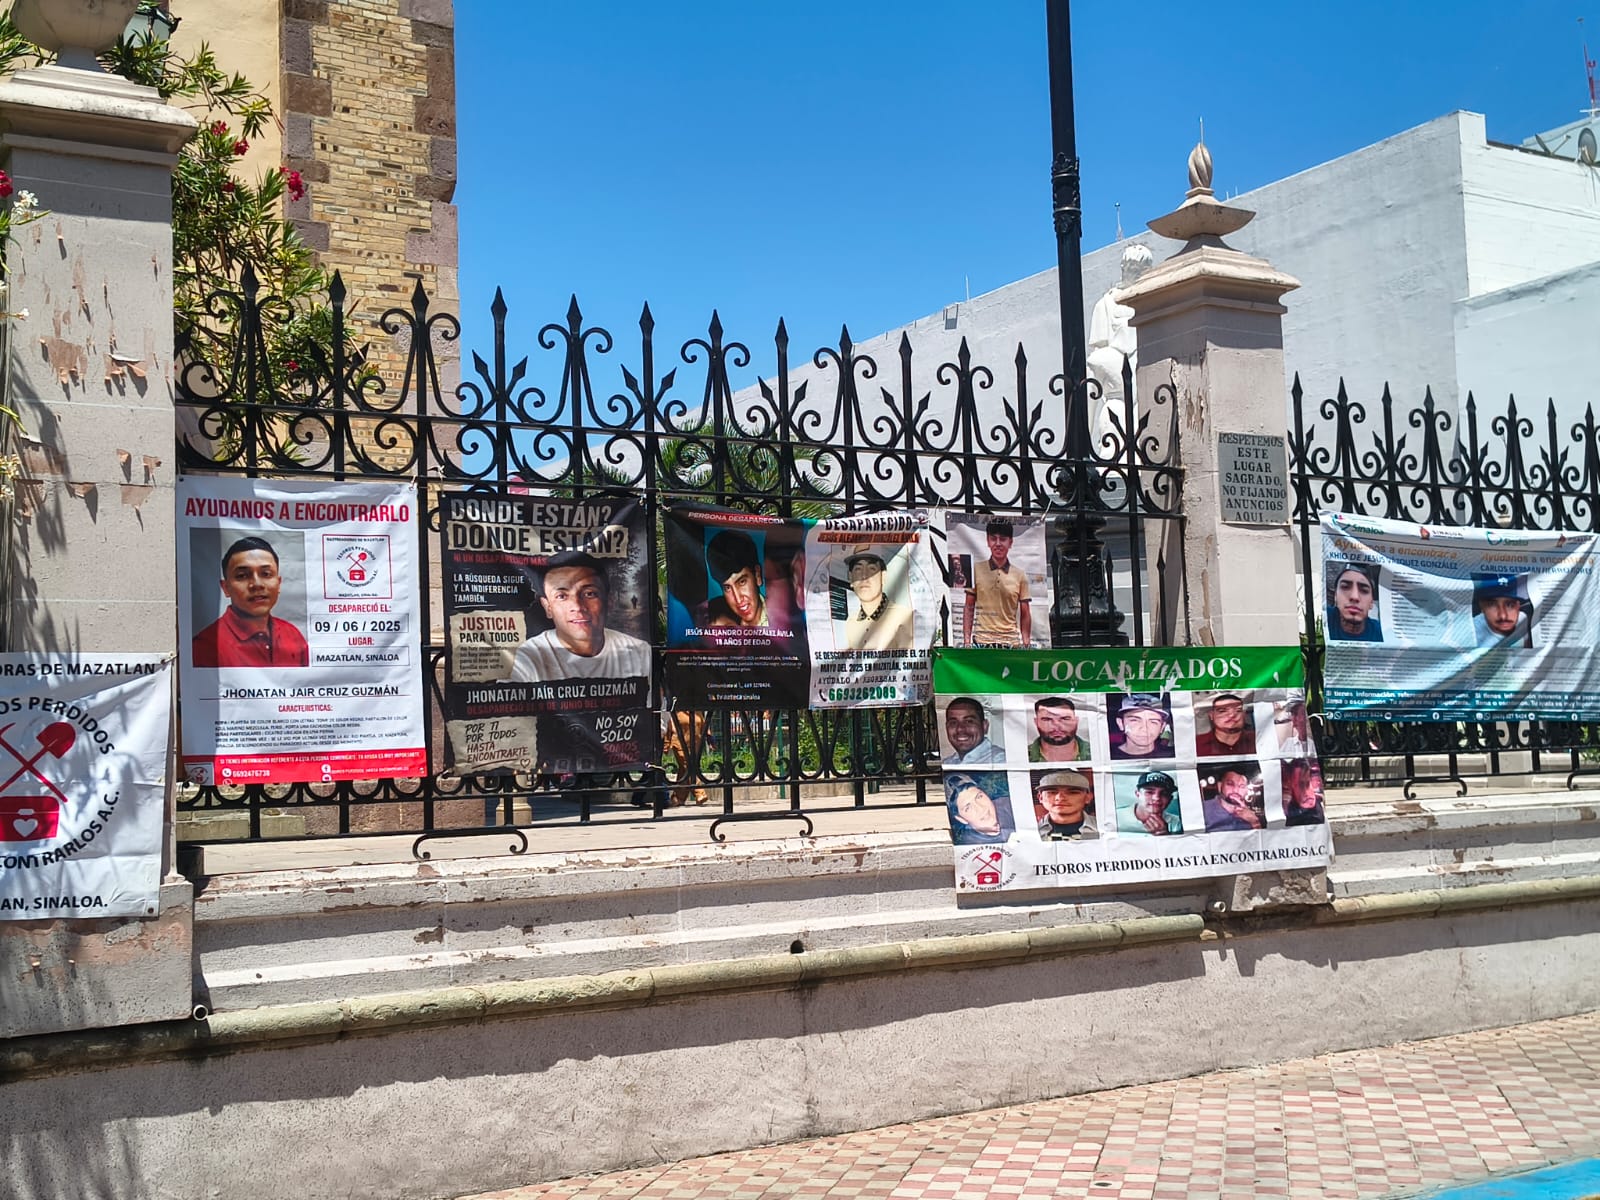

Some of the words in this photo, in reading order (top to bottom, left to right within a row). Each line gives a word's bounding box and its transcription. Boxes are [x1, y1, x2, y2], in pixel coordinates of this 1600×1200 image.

[1219, 432, 1284, 447] RESPETEMOS
[1238, 448, 1268, 459] ESTE
[1234, 461, 1272, 472] LUGAR
[1226, 473, 1282, 486] SAGRADO.
[1222, 485, 1236, 496] NO
[1240, 486, 1286, 498] FIJANDO
[185, 498, 274, 520] AYUDANOS
[279, 504, 290, 520] A
[295, 503, 410, 522] ENCONTRARLO
[1226, 498, 1284, 510] ANUNCIOS
[452, 500, 524, 524] DONDE
[532, 500, 612, 528] ESTÁN?
[688, 512, 727, 520] PERSONA
[728, 515, 784, 524] DESAPARECIDA
[826, 516, 912, 531] DESAPARECIDO
[452, 524, 530, 552] DONDE
[1420, 558, 1458, 569] GONZÁLEZ
[1480, 564, 1508, 572] CARLOS
[454, 574, 462, 582] LA
[464, 573, 502, 584] BÚSQUEDA
[503, 576, 525, 584] SIGUE
[454, 584, 458, 592] Y
[460, 584, 470, 592] LA
[471, 584, 518, 594] INDIFERENCIA
[454, 593, 488, 603] TAMBIÉN.
[328, 603, 378, 613] DESAPARECIÓ
[381, 604, 392, 613] EL:
[315, 622, 330, 632] 09
[343, 622, 358, 632] 06
[370, 620, 400, 632] 2025
[459, 616, 516, 631] JUSTICIA
[460, 632, 486, 642] PARA
[489, 632, 520, 642] TODOS
[686, 628, 703, 636] JESÚS
[704, 628, 742, 637] ALEJANDRO
[348, 637, 375, 646] LUGAR:
[724, 638, 742, 646] AÑOS
[316, 654, 364, 662] MAZATLAN,
[366, 654, 400, 662] SINALOA
[815, 651, 822, 660] SE
[910, 650, 916, 658] EL
[918, 649, 926, 658] 21
[0, 663, 36, 676] RAS
[41, 664, 62, 676] DE
[67, 662, 156, 676] MAZATLAN
[838, 664, 847, 672] DEL
[849, 663, 864, 672] 2025
[865, 663, 872, 671] EN
[1032, 657, 1242, 682] LOCALIZADOS
[222, 688, 286, 698] JHONATAN
[290, 688, 314, 697] JAIR
[318, 687, 348, 696] CRUZ
[352, 684, 399, 696] GUZMÁN
[466, 690, 526, 704] JHONATAN
[531, 685, 554, 700] JAÍR
[558, 686, 586, 698] CRUZ
[590, 682, 637, 696] GUZMÁN
[828, 686, 896, 700] 6693262089
[28, 696, 115, 754] PERDIDOS
[465, 724, 485, 734] POR
[490, 721, 500, 730] TI
[596, 716, 612, 730] NO
[616, 714, 638, 728] SOY
[466, 734, 484, 744] POR
[489, 730, 517, 741] TODOS
[600, 728, 632, 744] SOLO
[468, 741, 495, 754] HASTA
[468, 746, 528, 763] ENCONTRARTE
[104, 790, 120, 822] A.C.
[1034, 862, 1092, 876] TESOROS
[1096, 858, 1161, 873] PERDIDOS
[1165, 856, 1209, 868] HASTA
[1211, 847, 1308, 865] ENCONTRARLOS
[34, 896, 108, 910] SINALOA.
